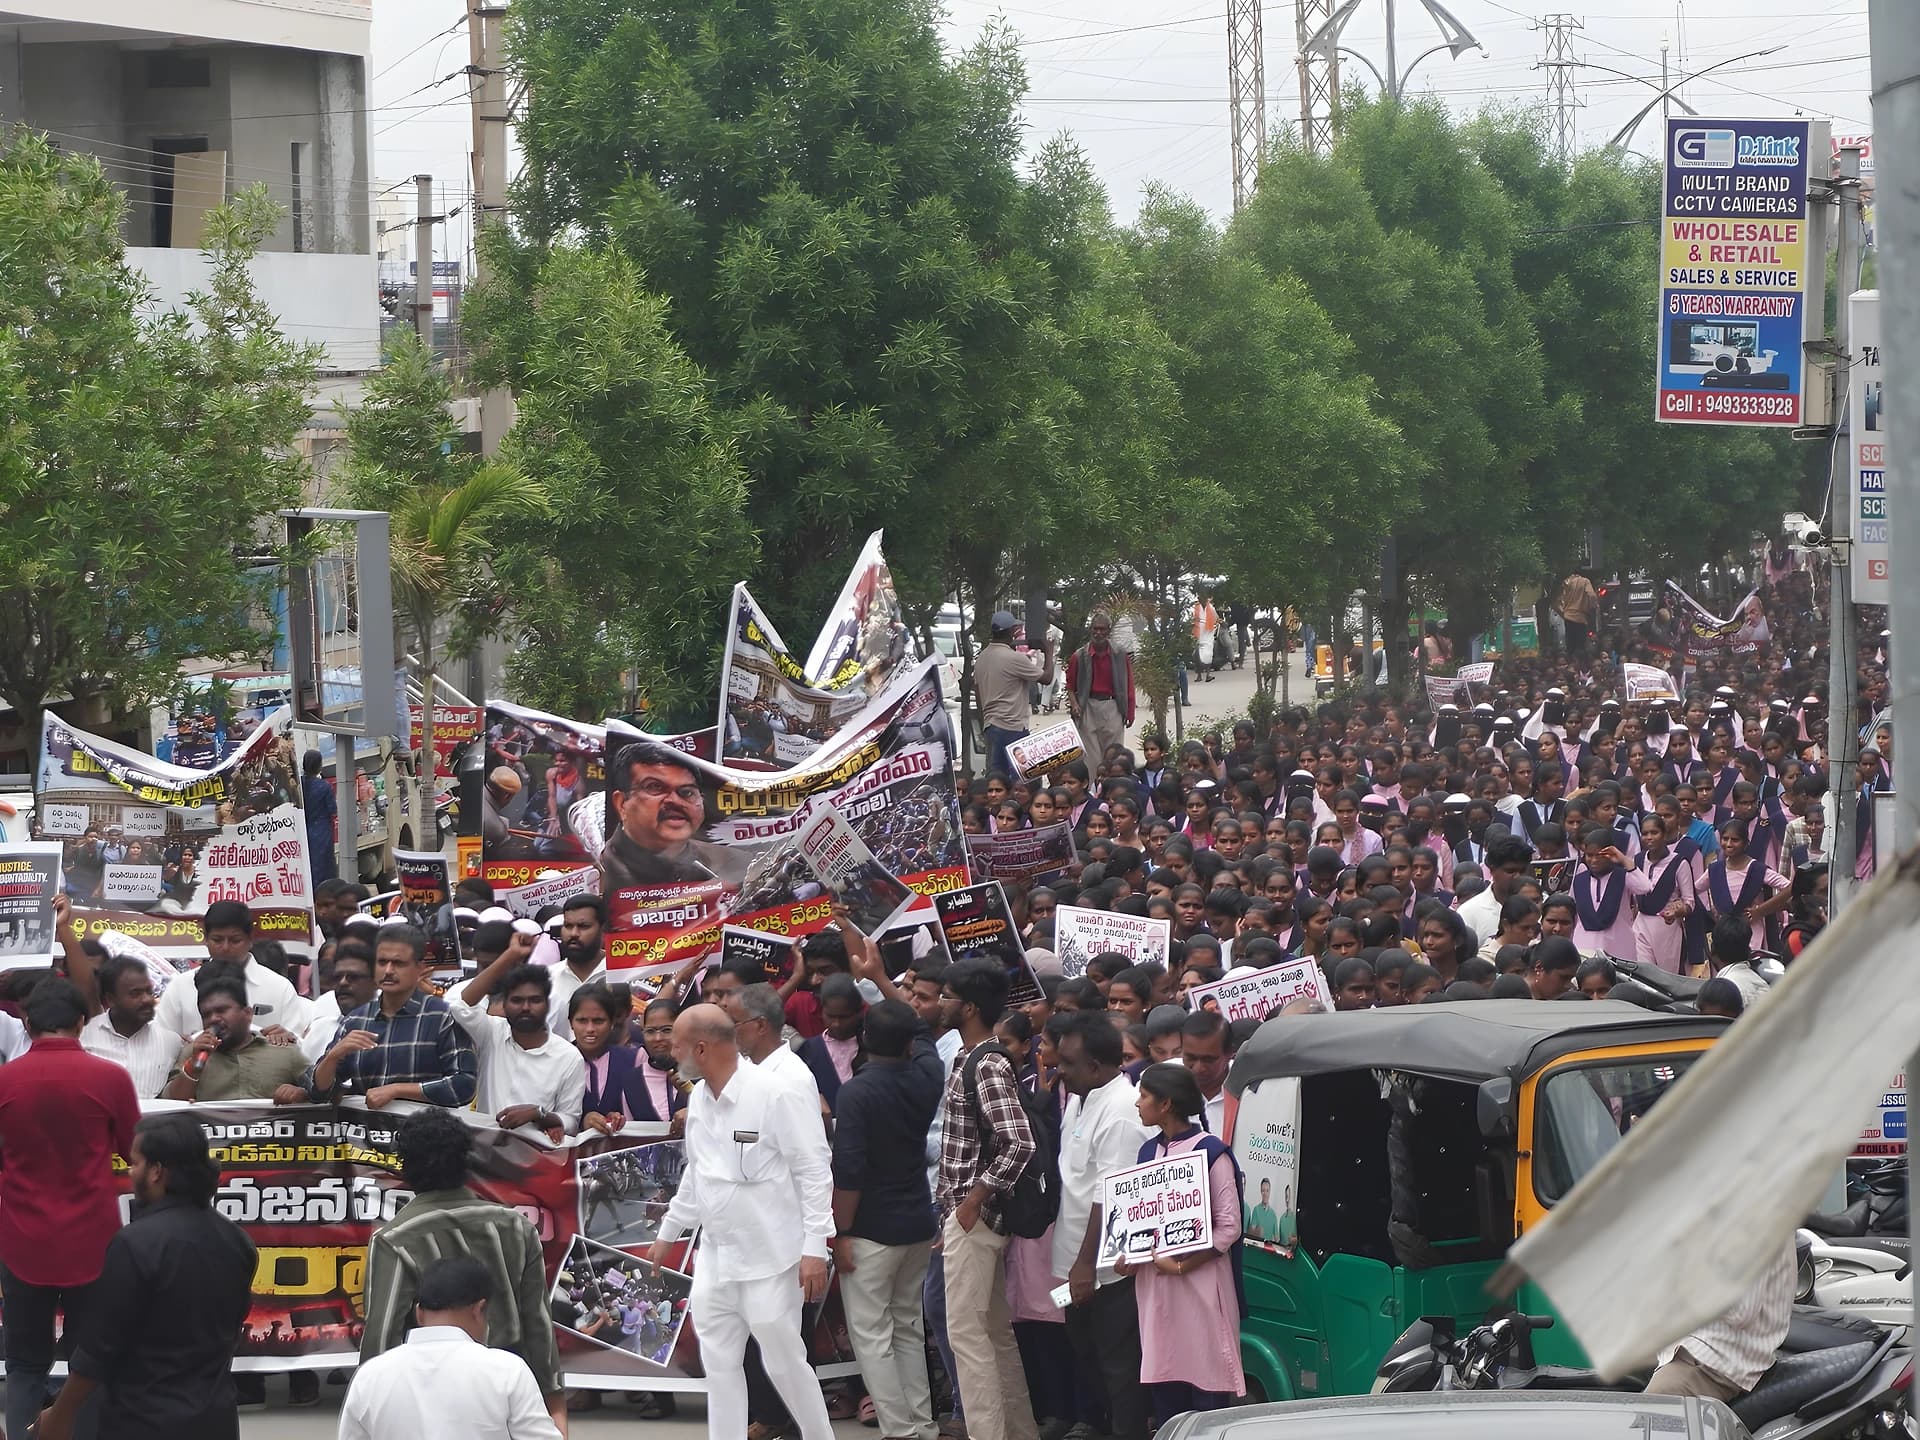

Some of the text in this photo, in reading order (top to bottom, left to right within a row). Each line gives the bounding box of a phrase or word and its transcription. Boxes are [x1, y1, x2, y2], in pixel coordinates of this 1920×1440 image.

[1682, 174, 1790, 193] MULTI BRAND
[1674, 195, 1798, 213] CCTV CAMERAS
[1673, 223, 1798, 243] WHOLESALE
[1688, 244, 1781, 264] & RETAIL
[1670, 268, 1797, 287] SALES & SERVICE
[1670, 295, 1795, 317] 5 YEARS WARRANTY
[1666, 394, 1693, 413] Cell
[1705, 396, 1793, 416] 9493333928
[1874, 562, 1888, 577] 9
[790, 900, 833, 926] వేదిక
